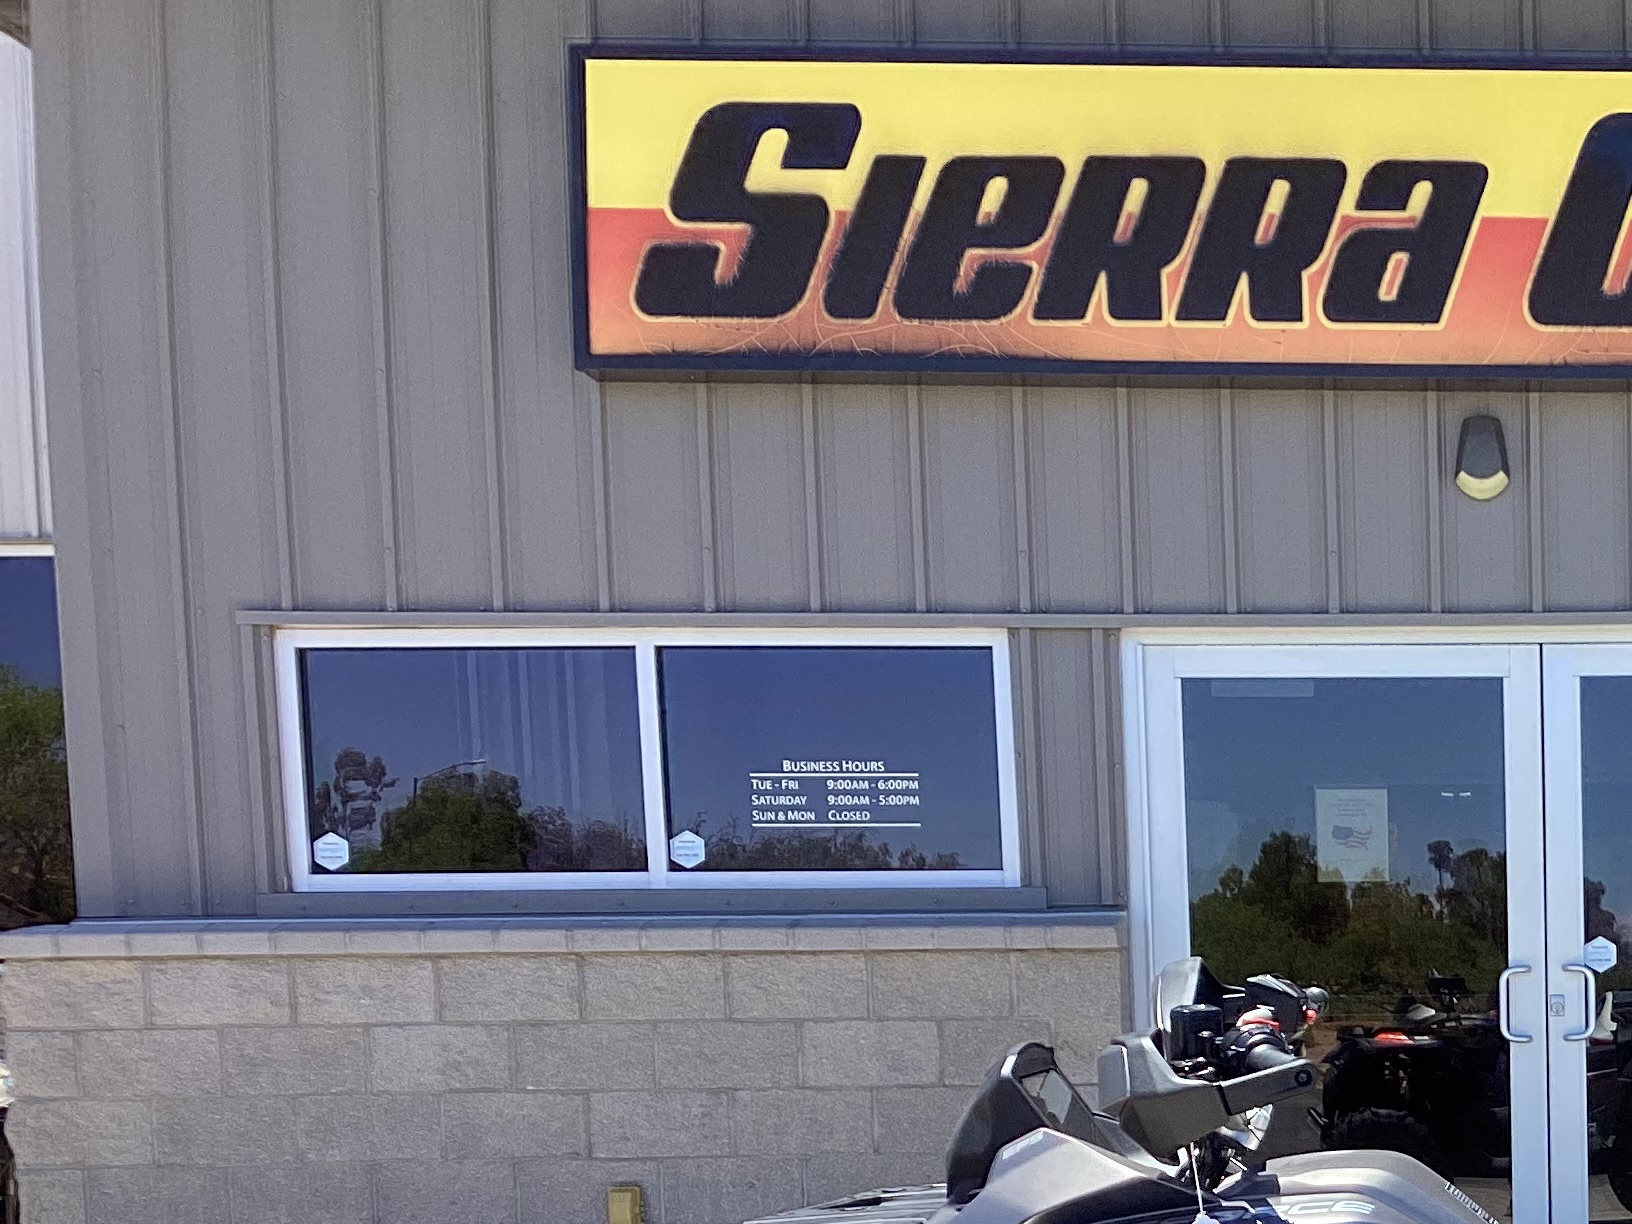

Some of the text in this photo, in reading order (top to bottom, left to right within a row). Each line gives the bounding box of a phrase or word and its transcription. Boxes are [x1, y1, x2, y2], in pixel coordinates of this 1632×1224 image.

[826, 779, 869, 790] 9:00AM
[877, 779, 919, 790] 6:00PM
[827, 795, 870, 806] 9:00AM
[878, 795, 920, 806] 5:00PM
[777, 810, 786, 821] &
